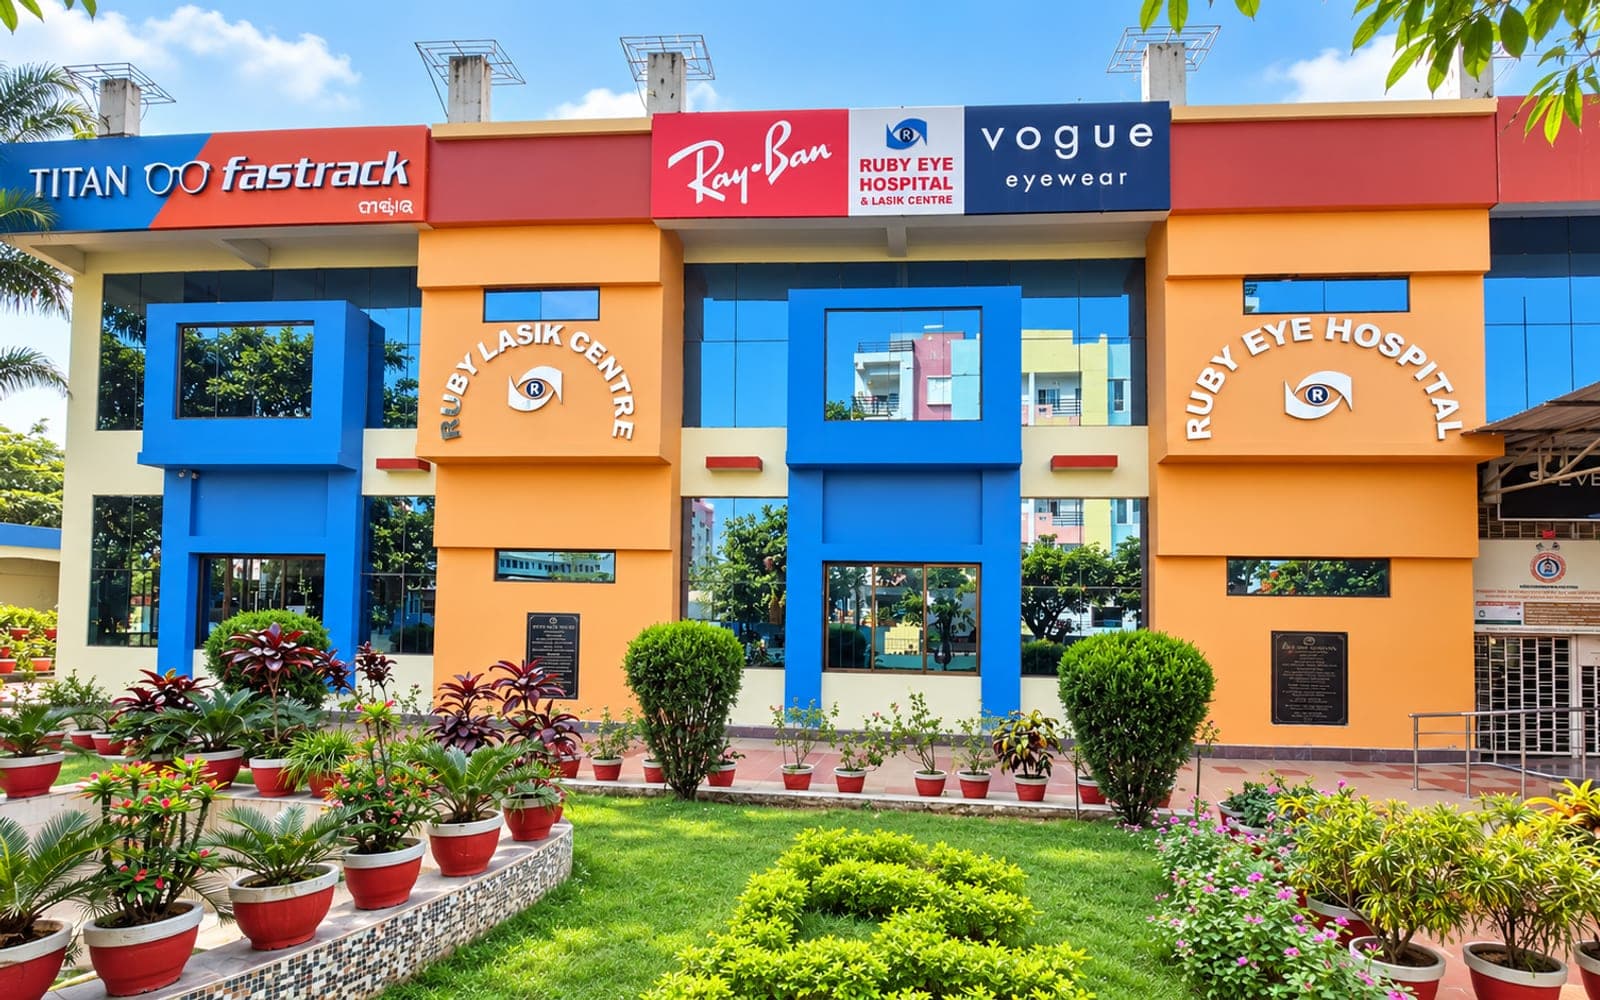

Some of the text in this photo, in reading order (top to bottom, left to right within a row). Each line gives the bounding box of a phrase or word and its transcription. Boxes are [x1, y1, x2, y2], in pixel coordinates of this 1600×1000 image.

[981, 122, 1153, 160] vogue
[221, 150, 409, 191] fastrack
[859, 157, 953, 172] RUBY EYE
[1006, 170, 1127, 193] eyewear
[29, 165, 128, 199] TITAN
[859, 176, 953, 191] HOSPITAL
[860, 195, 953, 206] & LASIK CENTRE
[440, 322, 635, 440] RUBY LASIK CENTRE
[1186, 317, 1463, 441] RUBY EYE HOSPITAL
